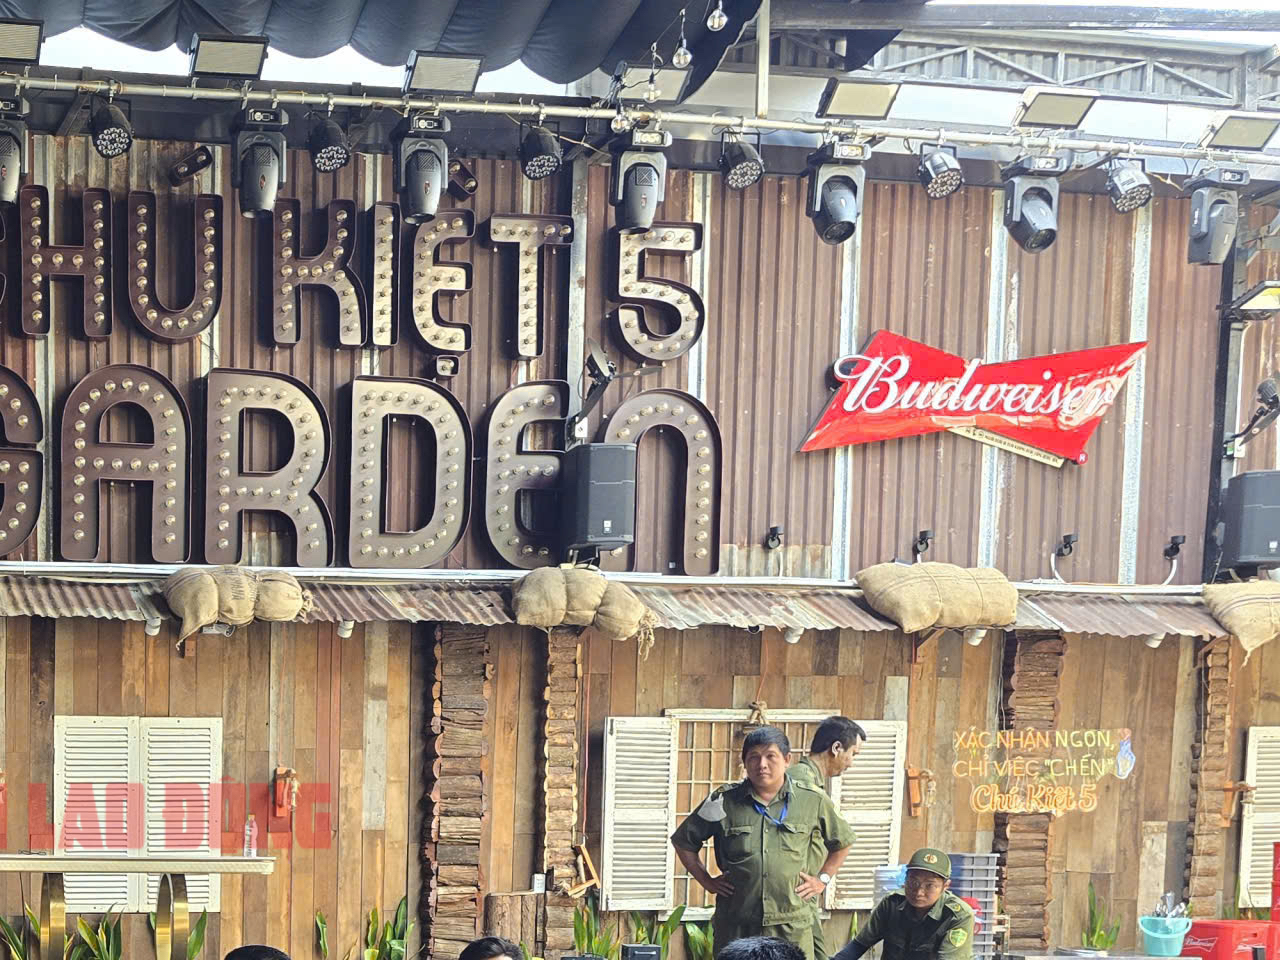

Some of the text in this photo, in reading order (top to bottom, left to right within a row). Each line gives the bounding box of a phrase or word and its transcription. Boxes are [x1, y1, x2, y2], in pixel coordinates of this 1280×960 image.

[611, 221, 707, 363] 5
[834, 355, 1116, 415] Budweiser
[954, 726, 991, 749] XÁC
[996, 727, 1049, 752] NHẬN
[952, 755, 988, 777] CHỈ
[972, 784, 1098, 812] Chú Kiệt 5
